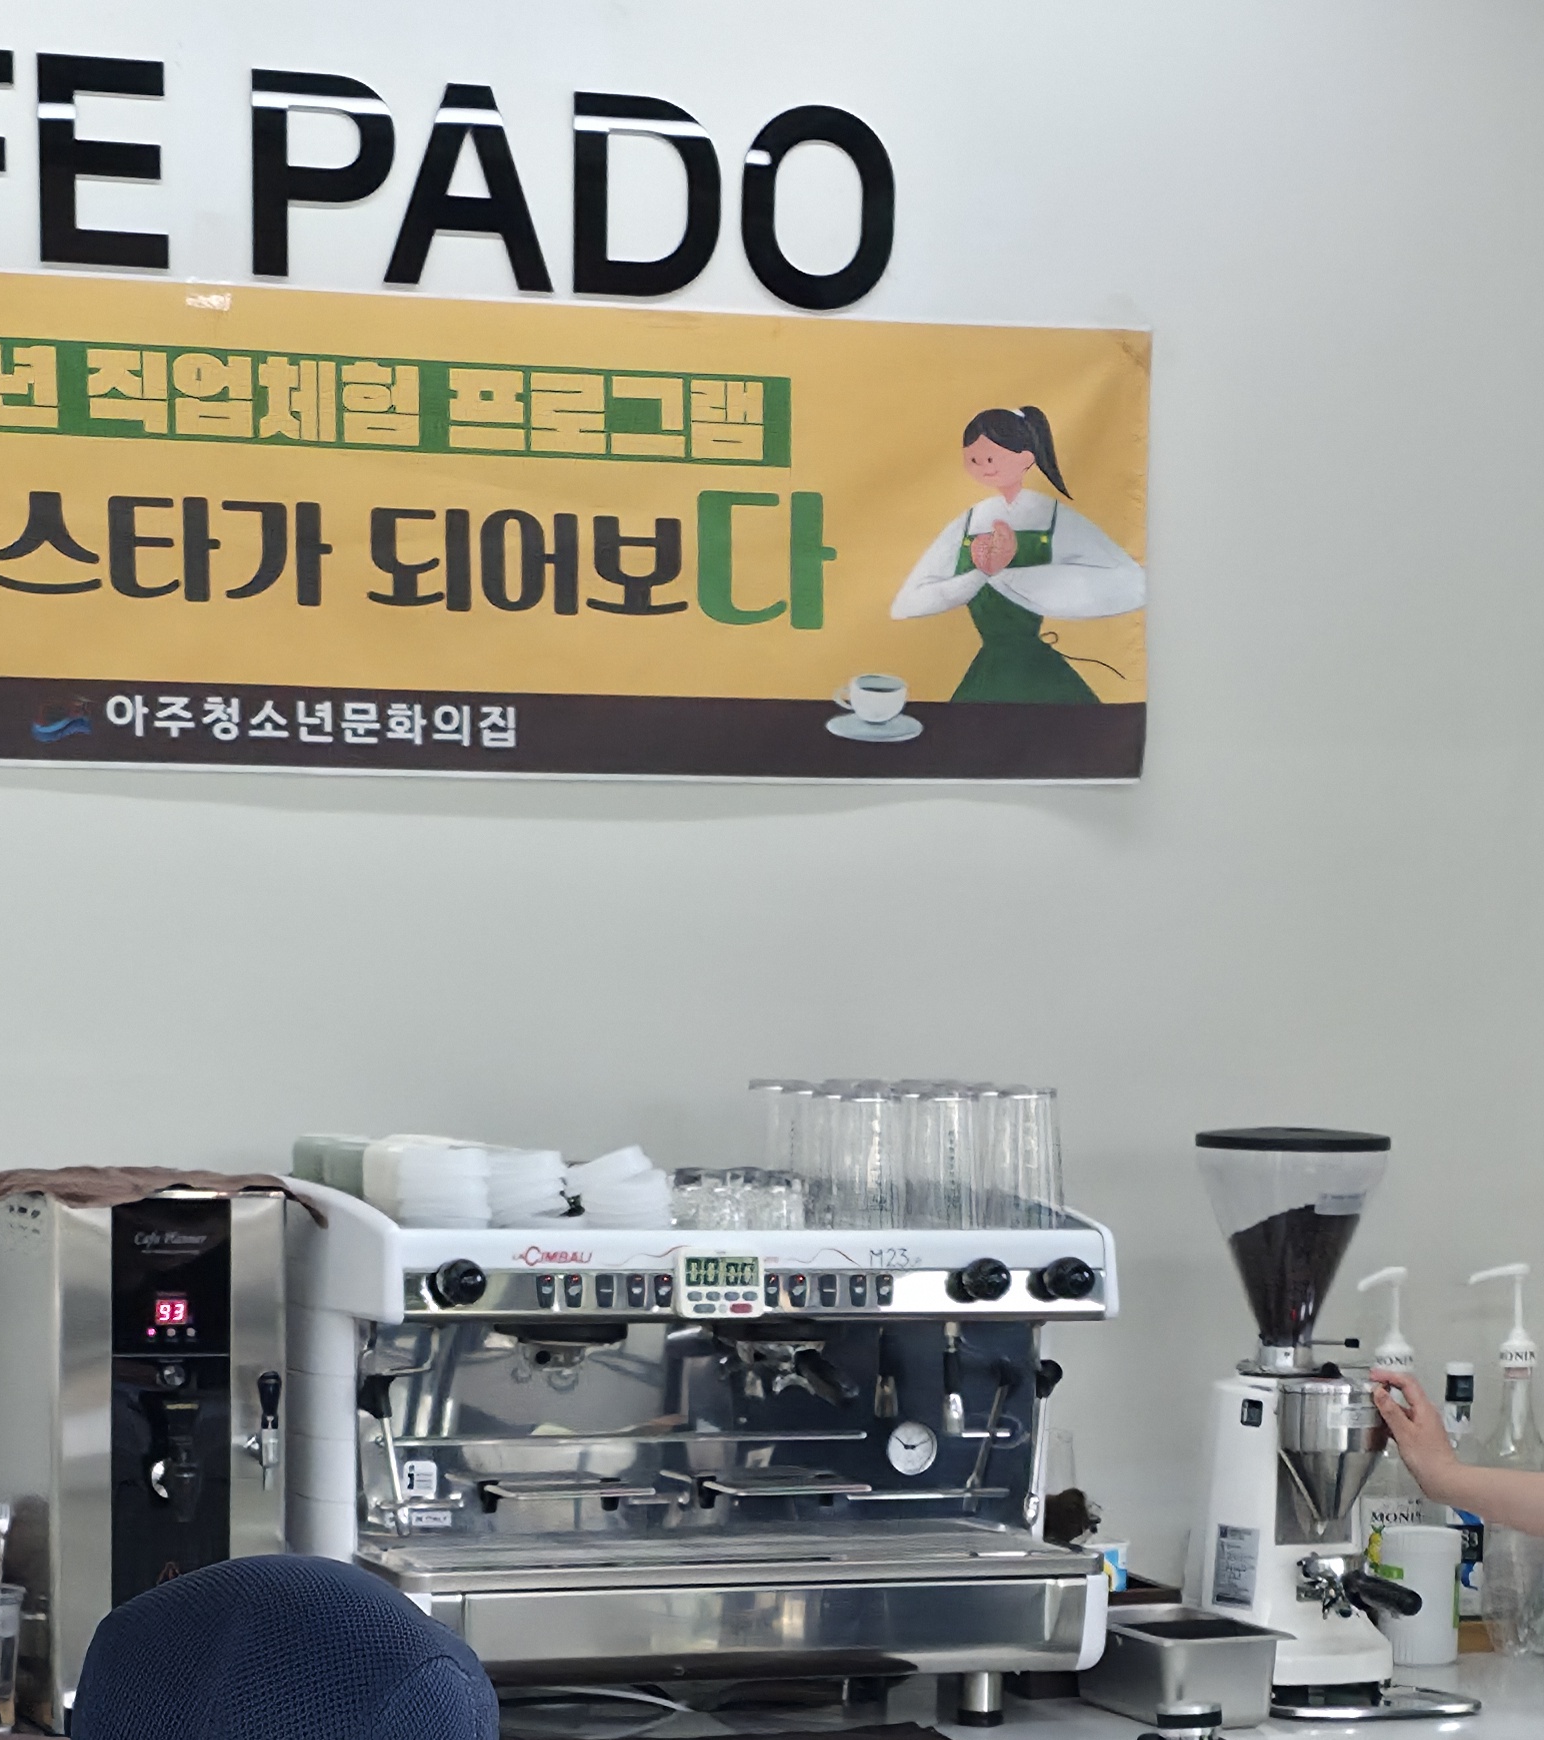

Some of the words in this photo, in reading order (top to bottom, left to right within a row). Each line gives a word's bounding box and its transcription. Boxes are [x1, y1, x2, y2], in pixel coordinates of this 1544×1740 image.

[251, 68, 895, 311] PADO
[85, 347, 420, 446] 직업체험
[448, 367, 764, 461] 프로그램
[366, 489, 838, 630] 되어보다
[106, 694, 517, 749] 아주청소년문화의집
[869, 1248, 908, 1268] M23
[159, 1303, 185, 1321] 93
